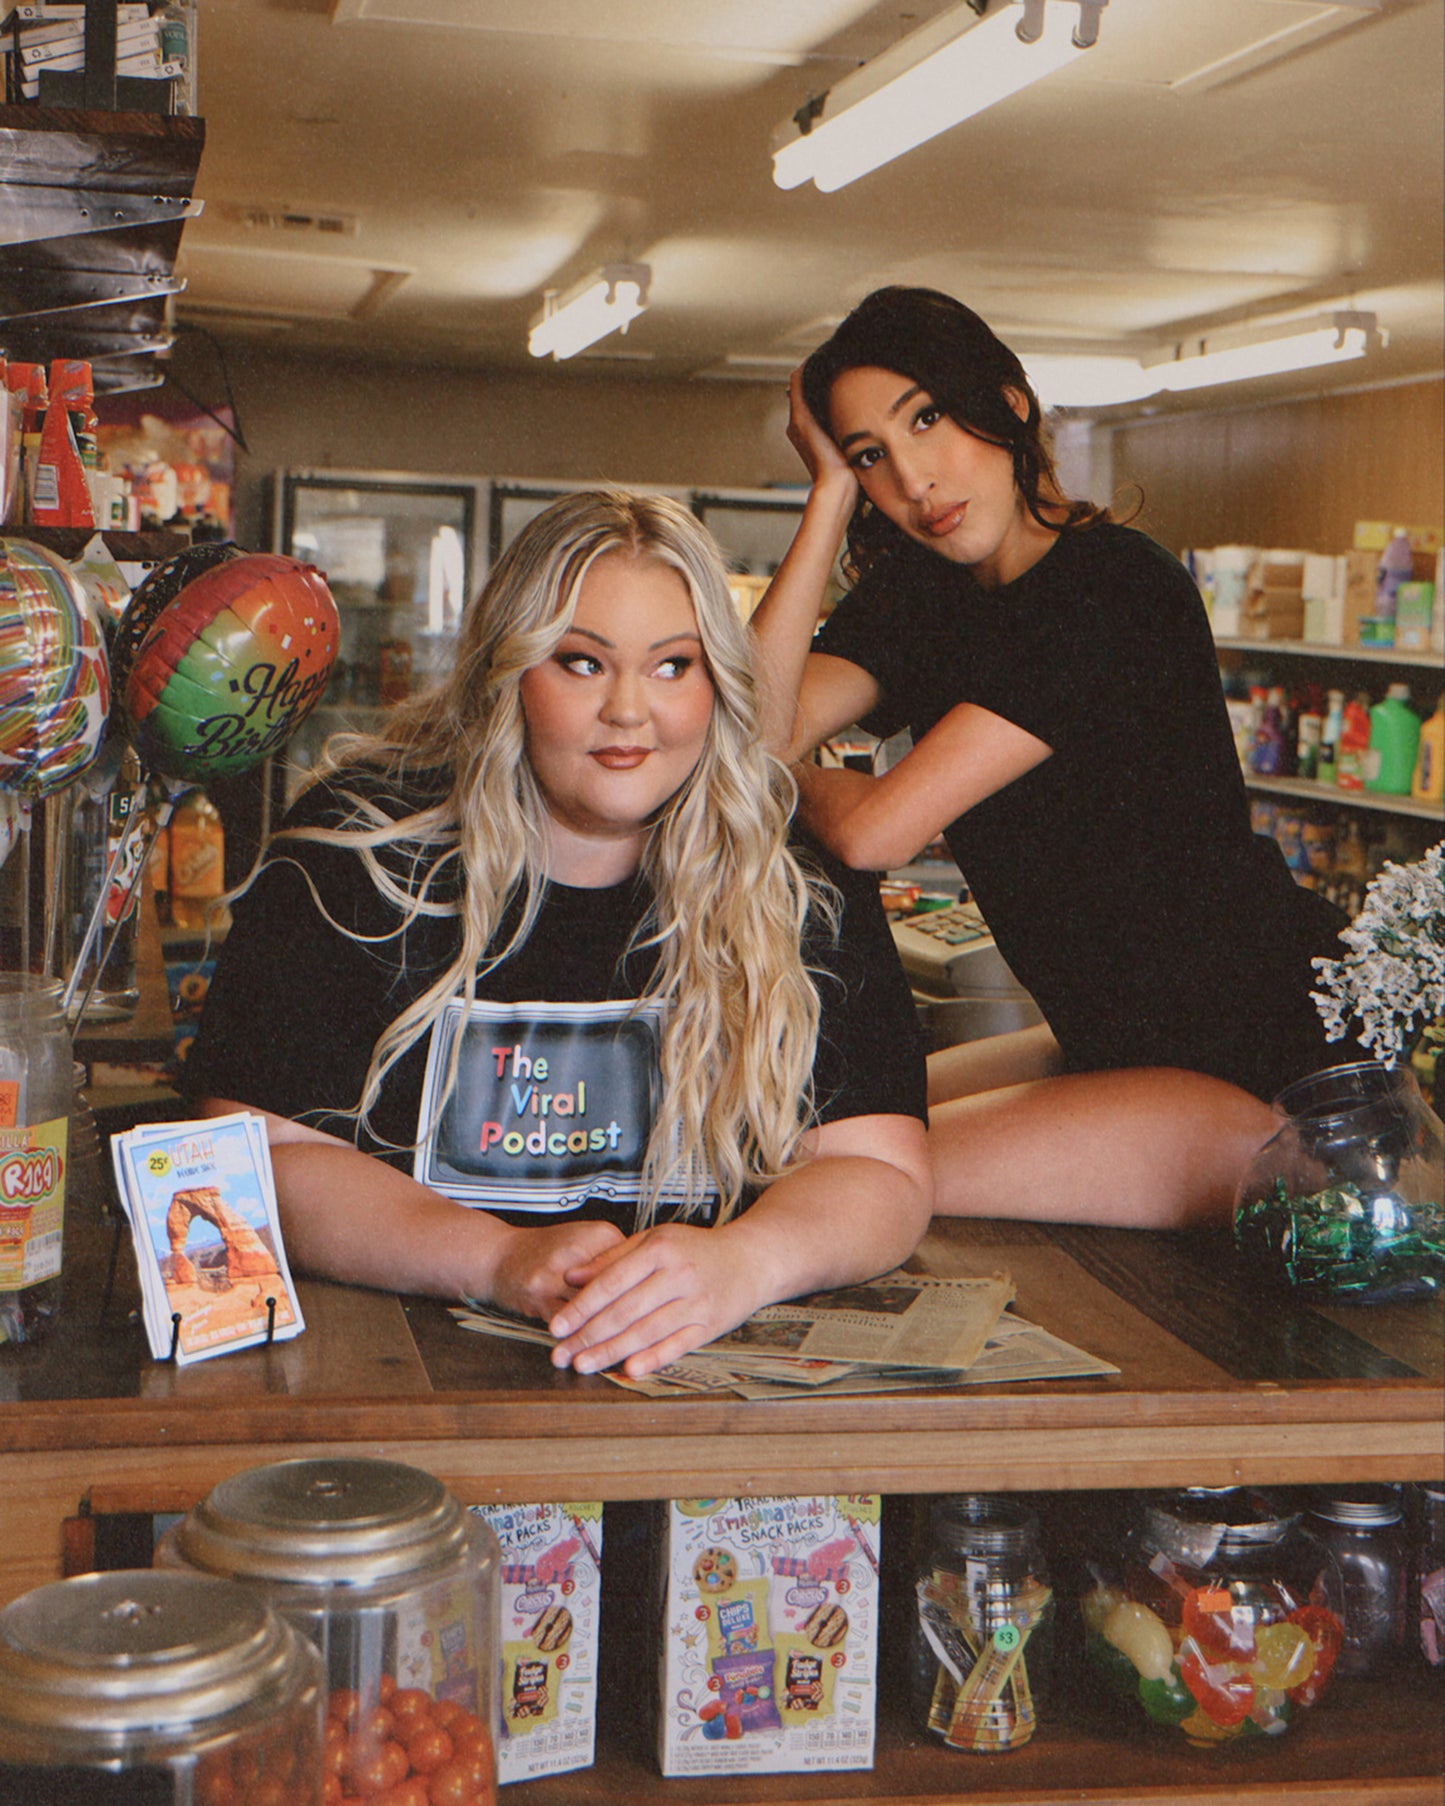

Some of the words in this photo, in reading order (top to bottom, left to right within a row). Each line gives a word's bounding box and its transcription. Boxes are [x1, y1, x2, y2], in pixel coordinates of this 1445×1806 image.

[491, 1044, 549, 1081] The
[511, 1080, 585, 1116] Viral
[168, 1136, 215, 1168] UTAH
[480, 1120, 622, 1156] Podcast
[516, 1520, 551, 1542] PACKS
[741, 1523, 784, 1544] SNACK
[788, 1516, 824, 1536] PACKS
[700, 1607, 708, 1620] 3
[720, 1603, 749, 1619] CHIPS
[999, 1631, 1013, 1644] $3
